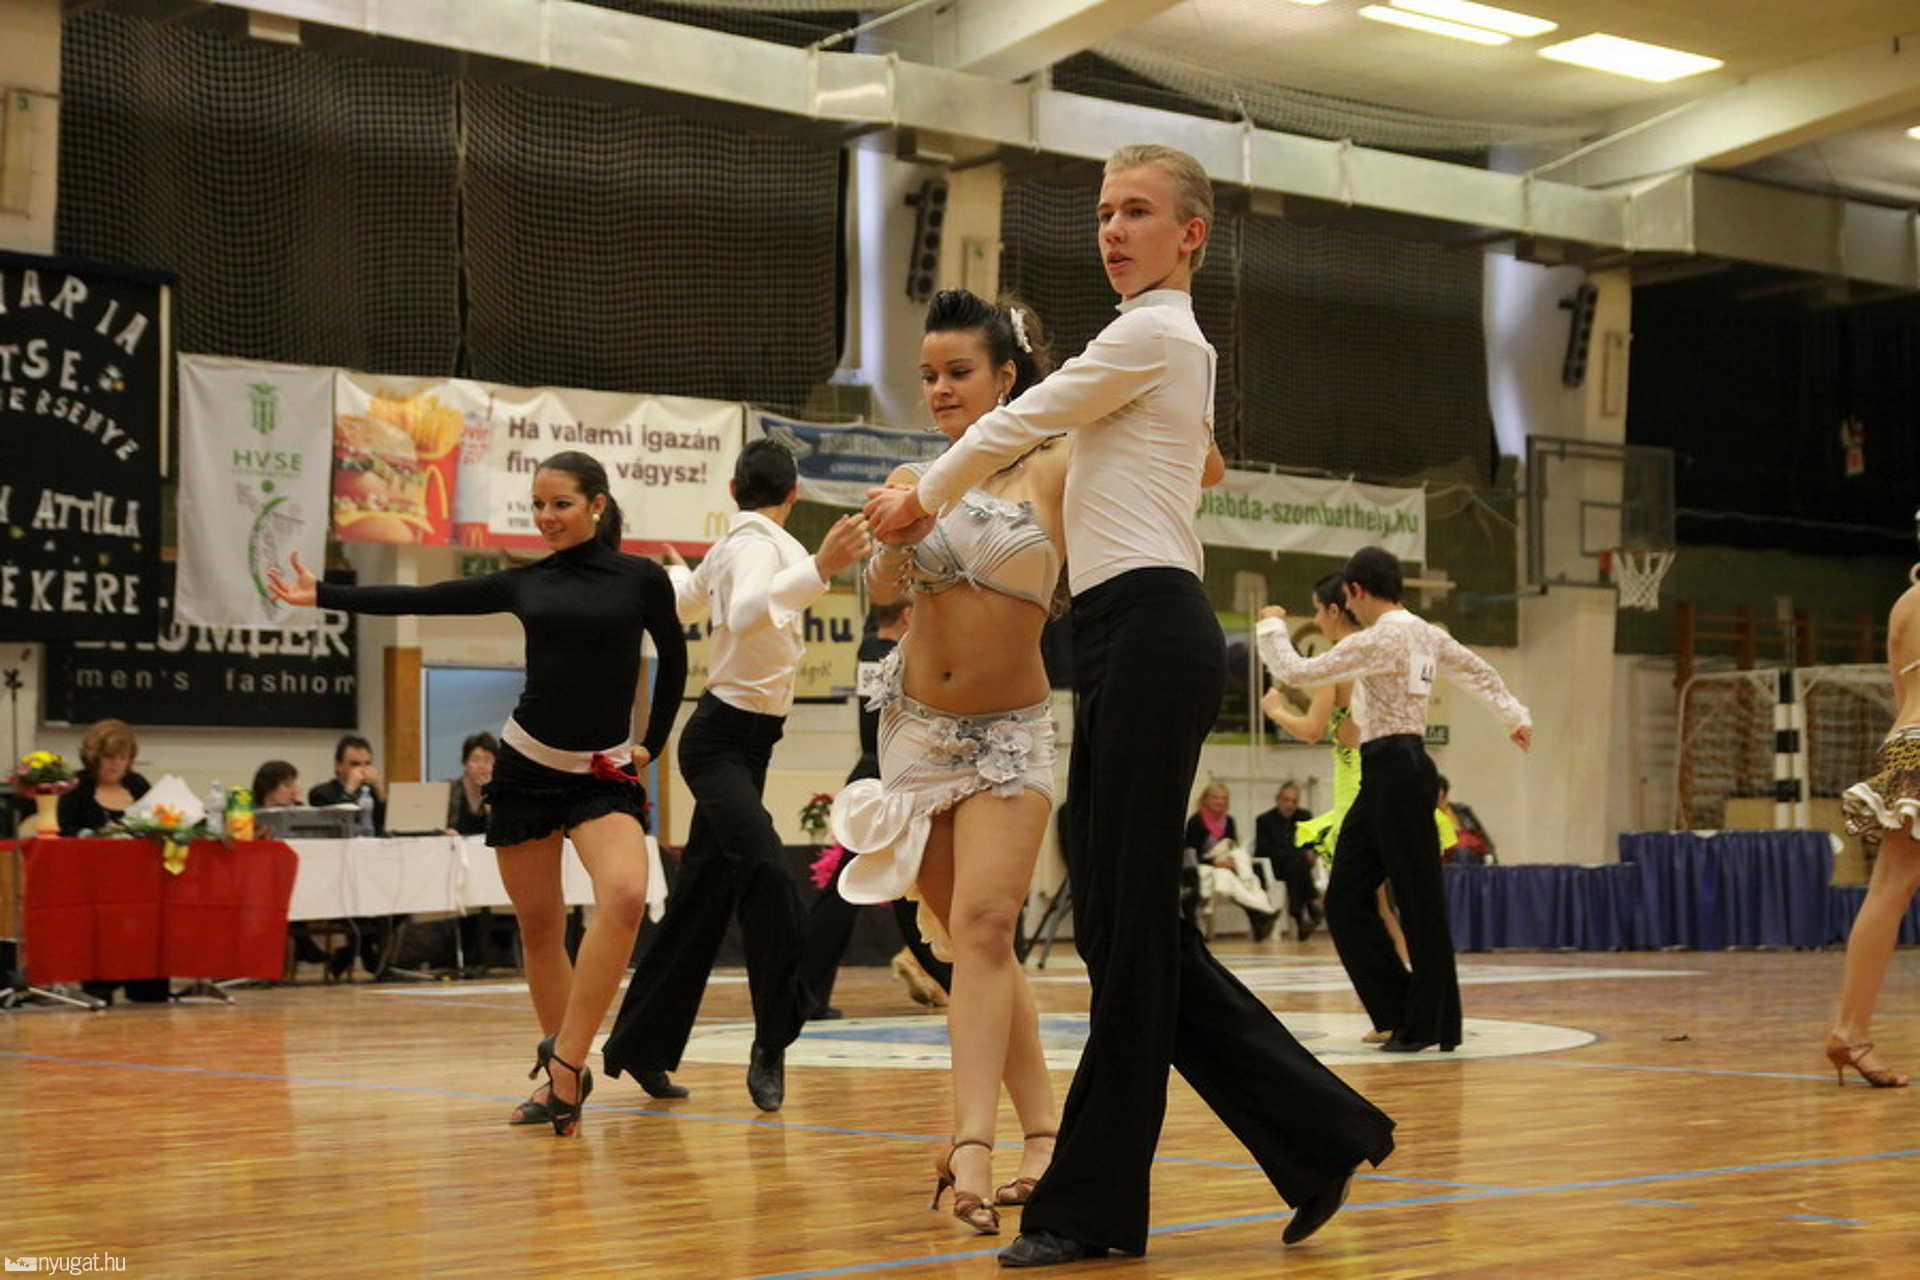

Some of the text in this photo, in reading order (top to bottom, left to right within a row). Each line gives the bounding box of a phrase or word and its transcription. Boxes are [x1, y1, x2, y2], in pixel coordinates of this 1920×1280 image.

[0, 269, 148, 354] ARIA
[0, 386, 139, 461] ERSENYE
[508, 417, 720, 453] Ha valami igazán
[233, 449, 303, 471] HVSE
[507, 452, 708, 487] fin vágysz!
[32, 488, 140, 537] ATTILA
[76, 668, 355, 694] men's fashion
